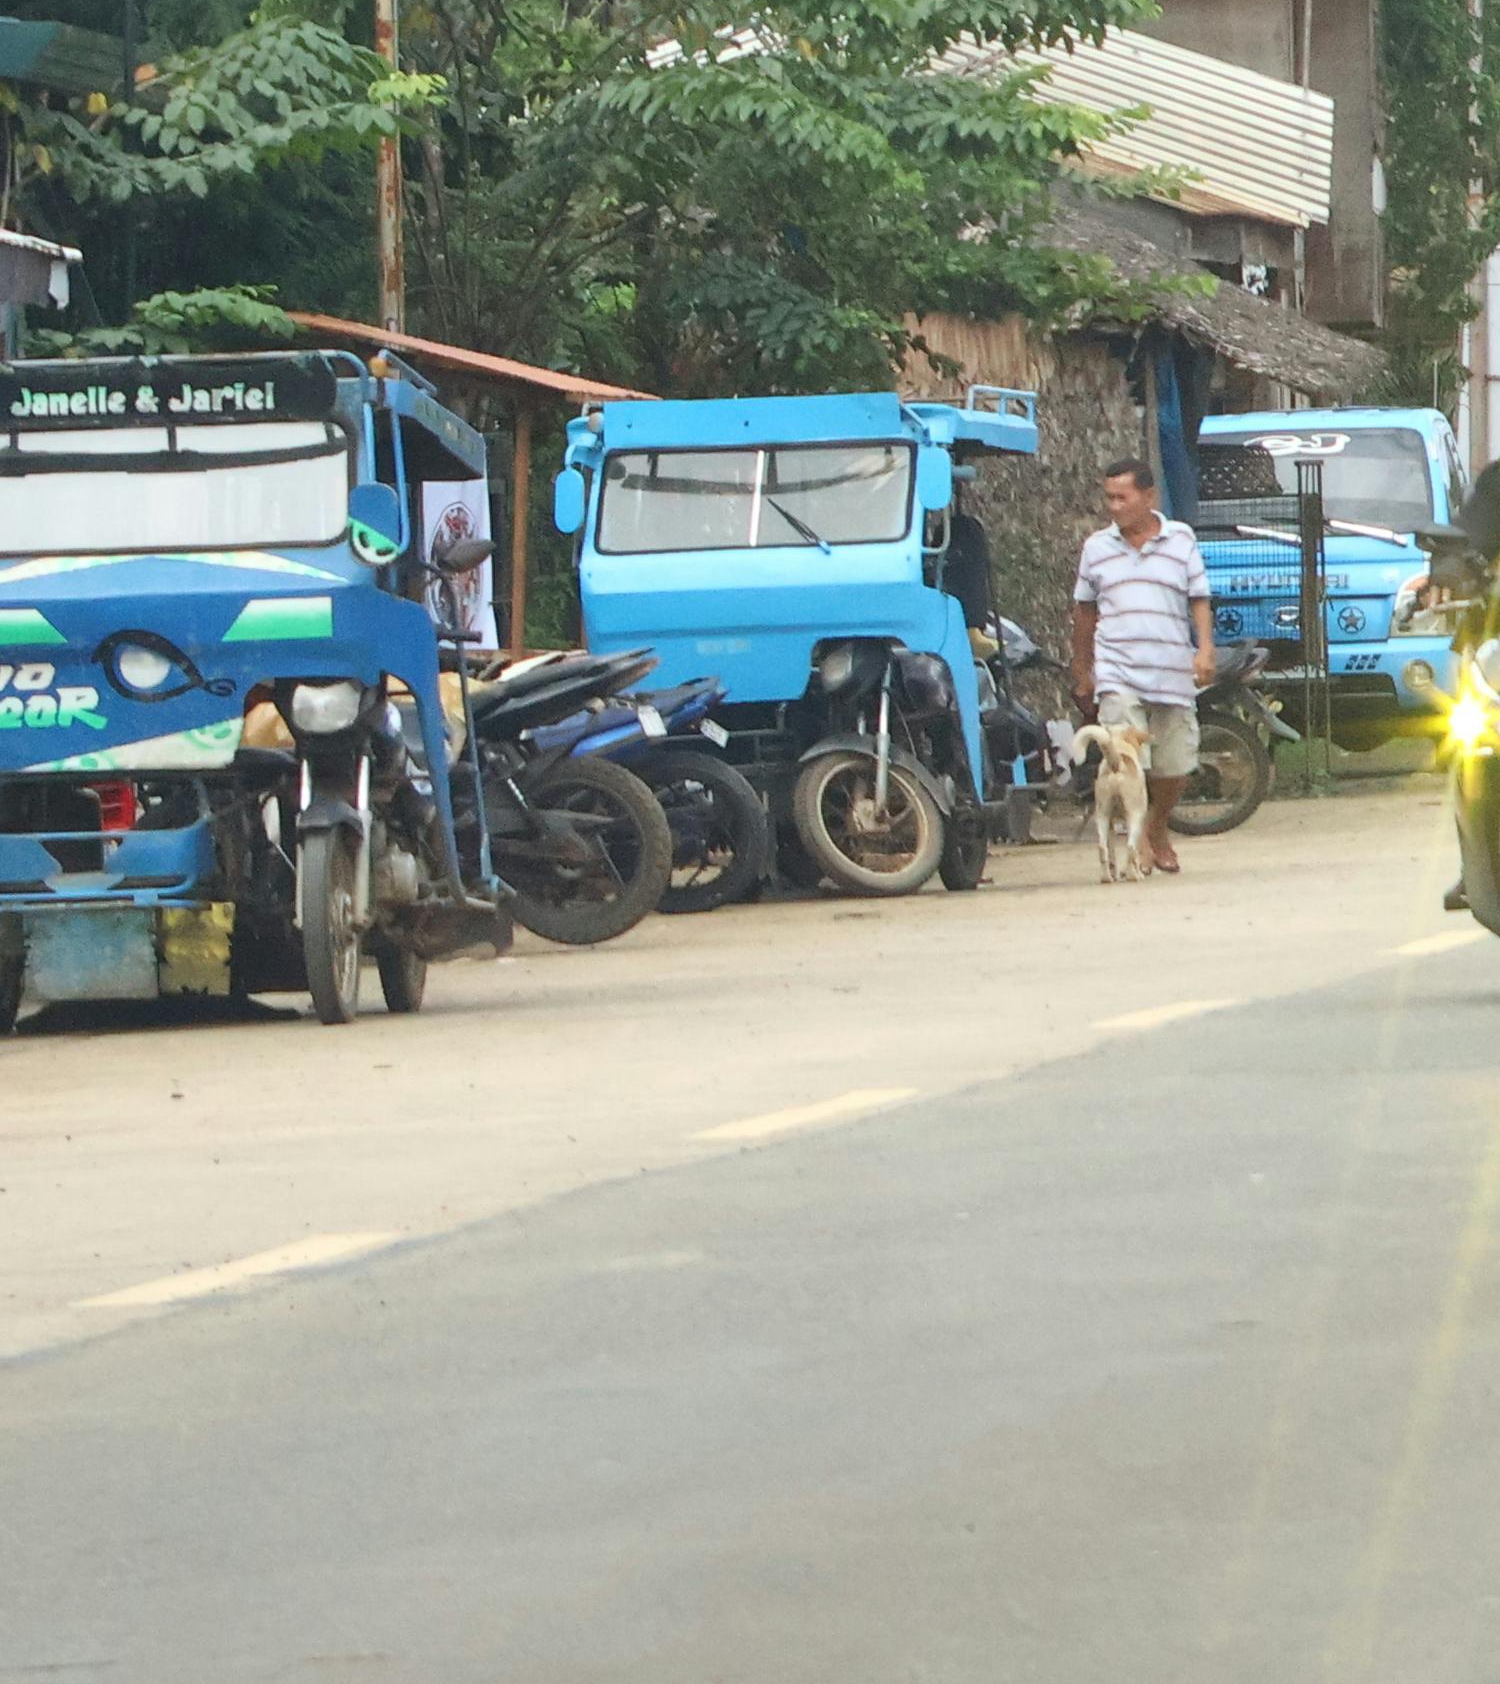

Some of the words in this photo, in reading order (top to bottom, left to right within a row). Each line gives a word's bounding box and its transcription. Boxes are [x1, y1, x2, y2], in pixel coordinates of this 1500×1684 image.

[10, 386, 127, 417] Janelle
[135, 384, 160, 414] &
[1230, 572, 1350, 592] HYUNAI
